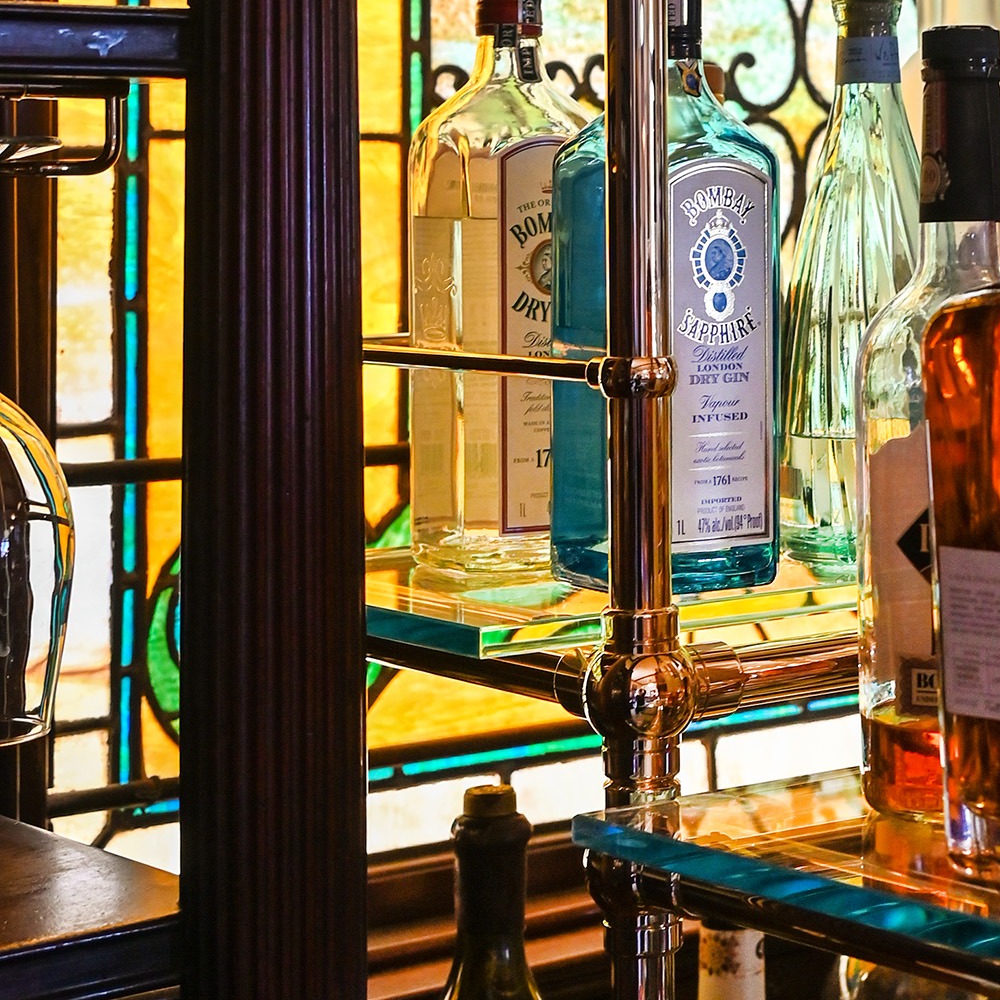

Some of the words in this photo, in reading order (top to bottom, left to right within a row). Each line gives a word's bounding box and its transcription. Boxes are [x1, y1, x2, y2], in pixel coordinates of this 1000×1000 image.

[517, 203, 536, 214] THE
[680, 186, 755, 226] BOMBAY
[509, 212, 552, 249] BOM
[511, 291, 551, 322] DRY
[677, 308, 758, 345] SAPPHIRE
[691, 345, 748, 363] Distilled
[697, 362, 743, 372] LONDON
[689, 374, 720, 385] DRY
[722, 372, 750, 384] GIN
[700, 394, 741, 412] Vapour
[692, 412, 748, 423] INFUSED
[696, 440, 720, 453] Hand
[713, 475, 731, 486] 1761
[701, 496, 742, 504] IMPORTED
[697, 506, 718, 514] PRODUCT
[725, 504, 746, 512] ENGLAND
[677, 520, 686, 536] 1L
